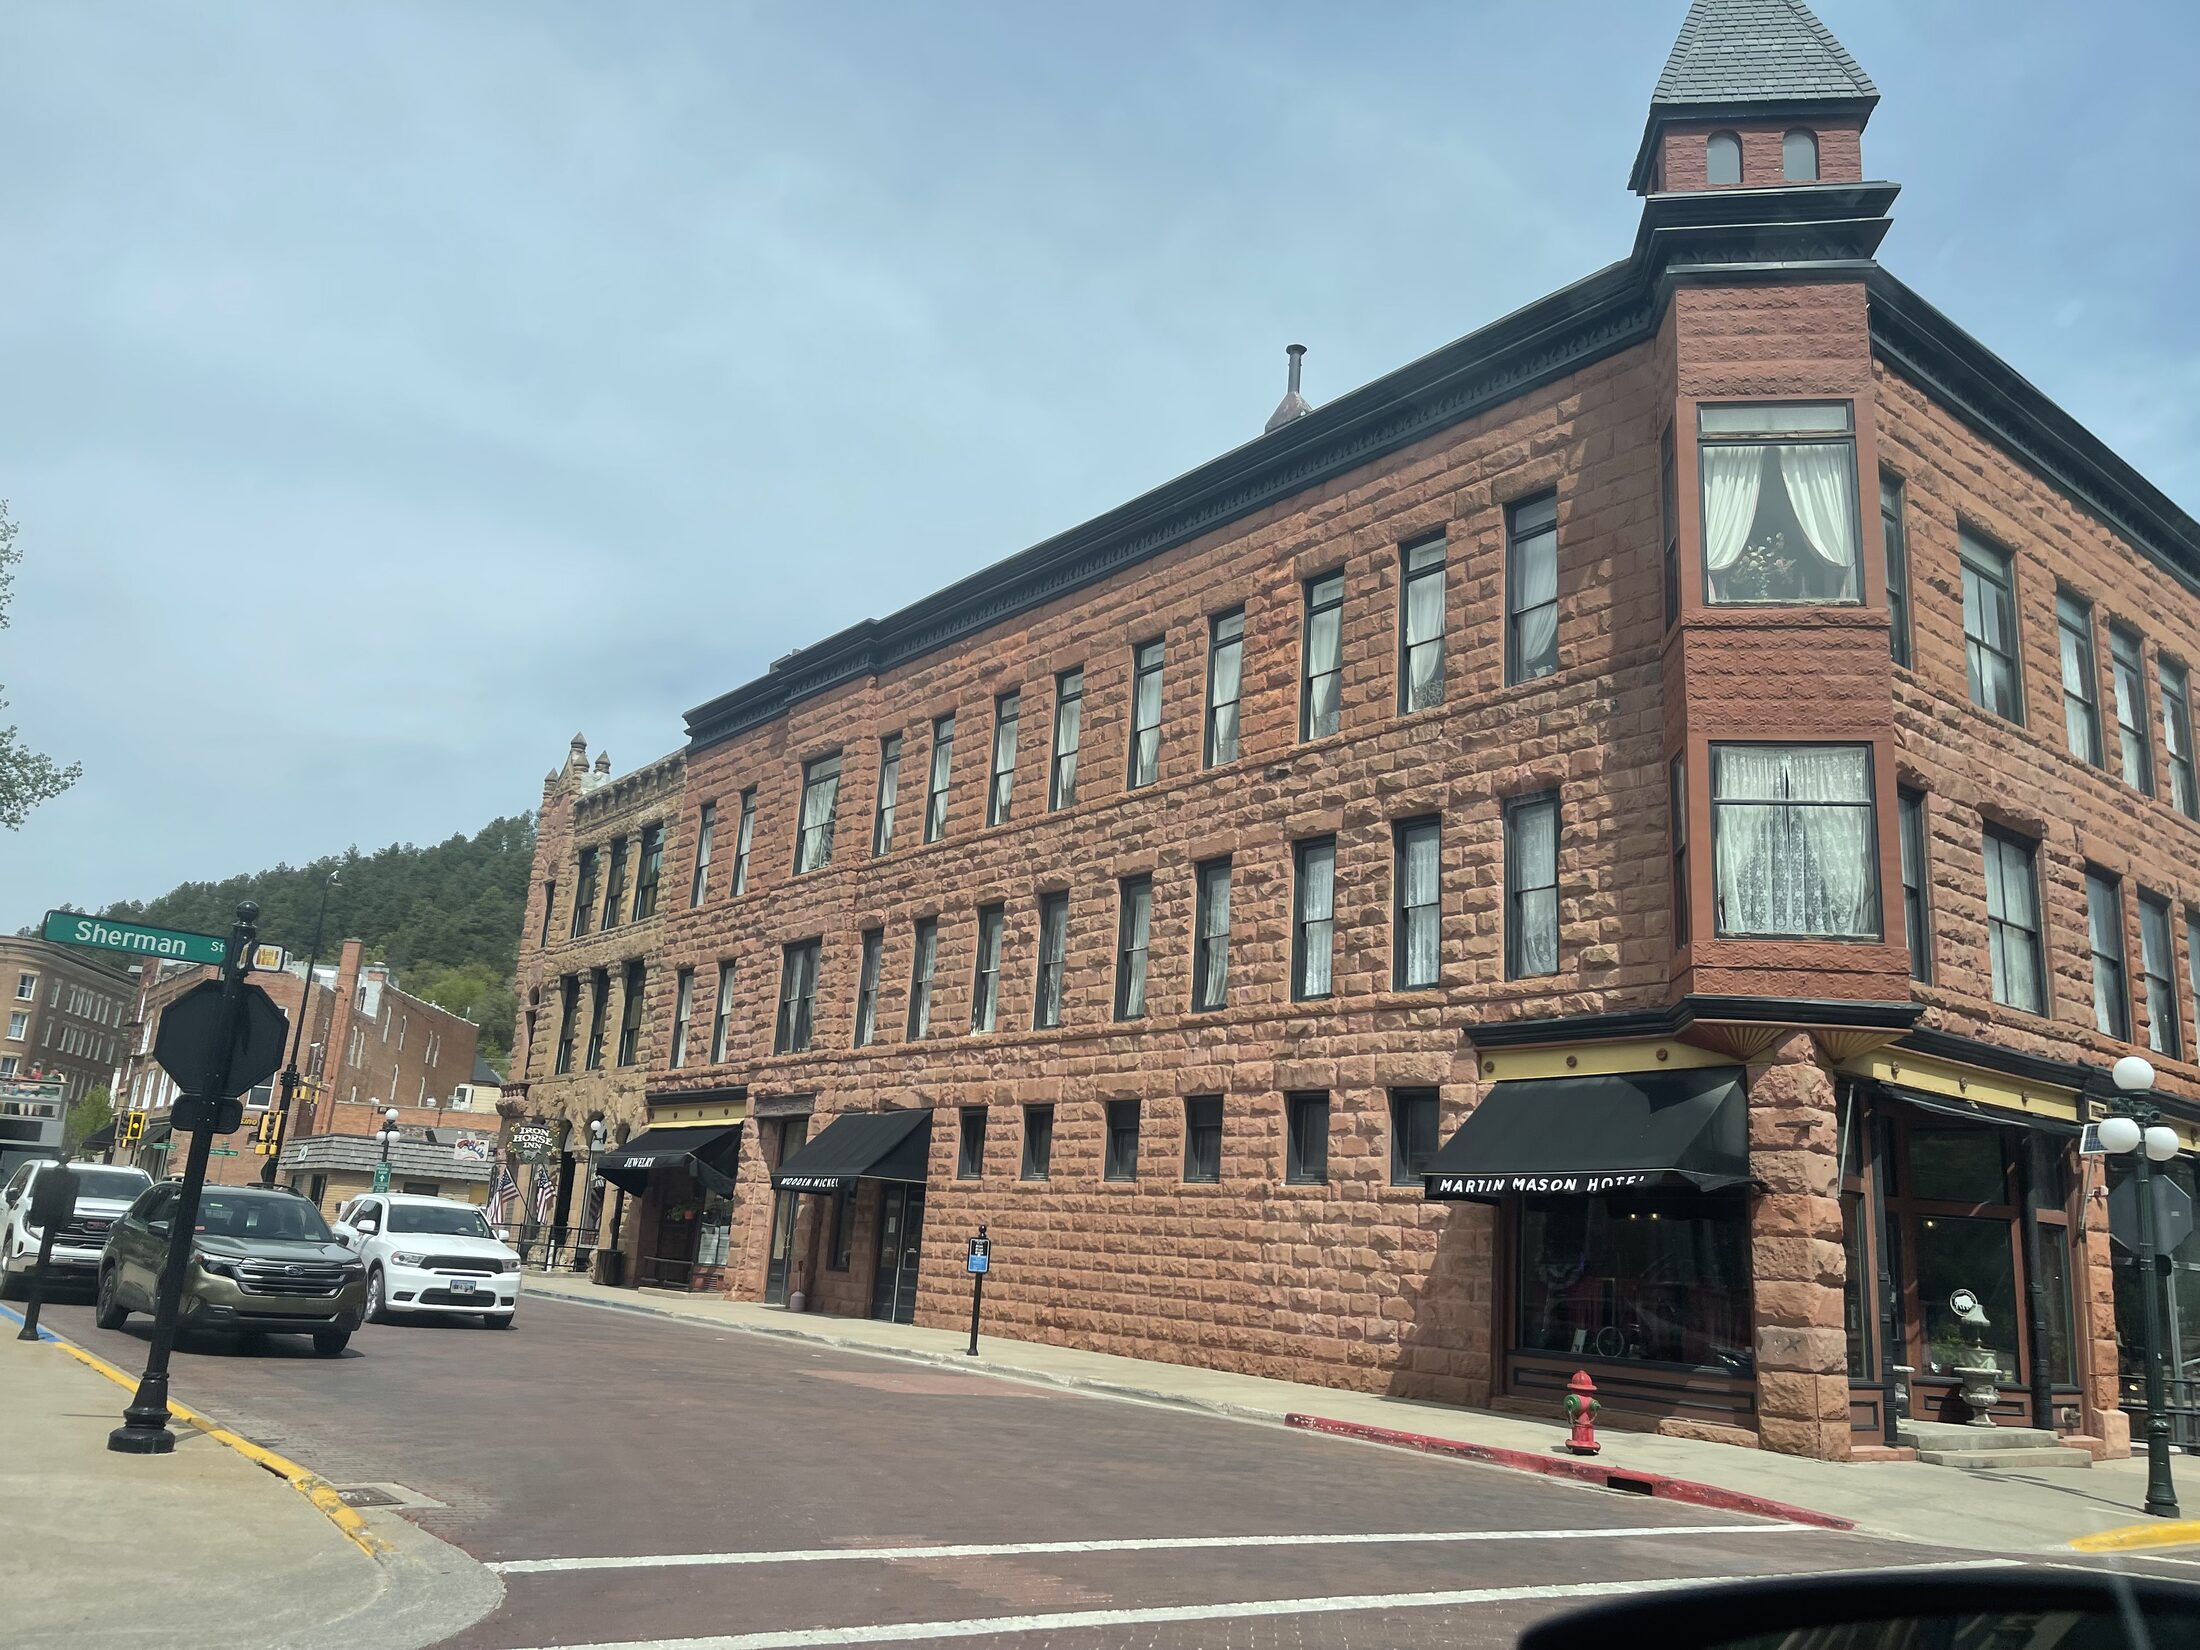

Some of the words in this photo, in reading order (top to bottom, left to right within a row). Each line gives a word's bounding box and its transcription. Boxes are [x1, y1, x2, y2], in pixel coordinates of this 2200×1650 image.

[75, 920, 187, 956] Sherman
[210, 941, 225, 953] St
[519, 1127, 551, 1137] IRON
[512, 1134, 553, 1147] HORSE
[523, 1142, 542, 1150] INN
[624, 1156, 656, 1168] JEWELRY
[780, 1177, 812, 1187] WOODEN
[813, 1178, 839, 1188] NICKEL
[1439, 1178, 1506, 1193] MARTIN
[1512, 1177, 1577, 1192] MASON
